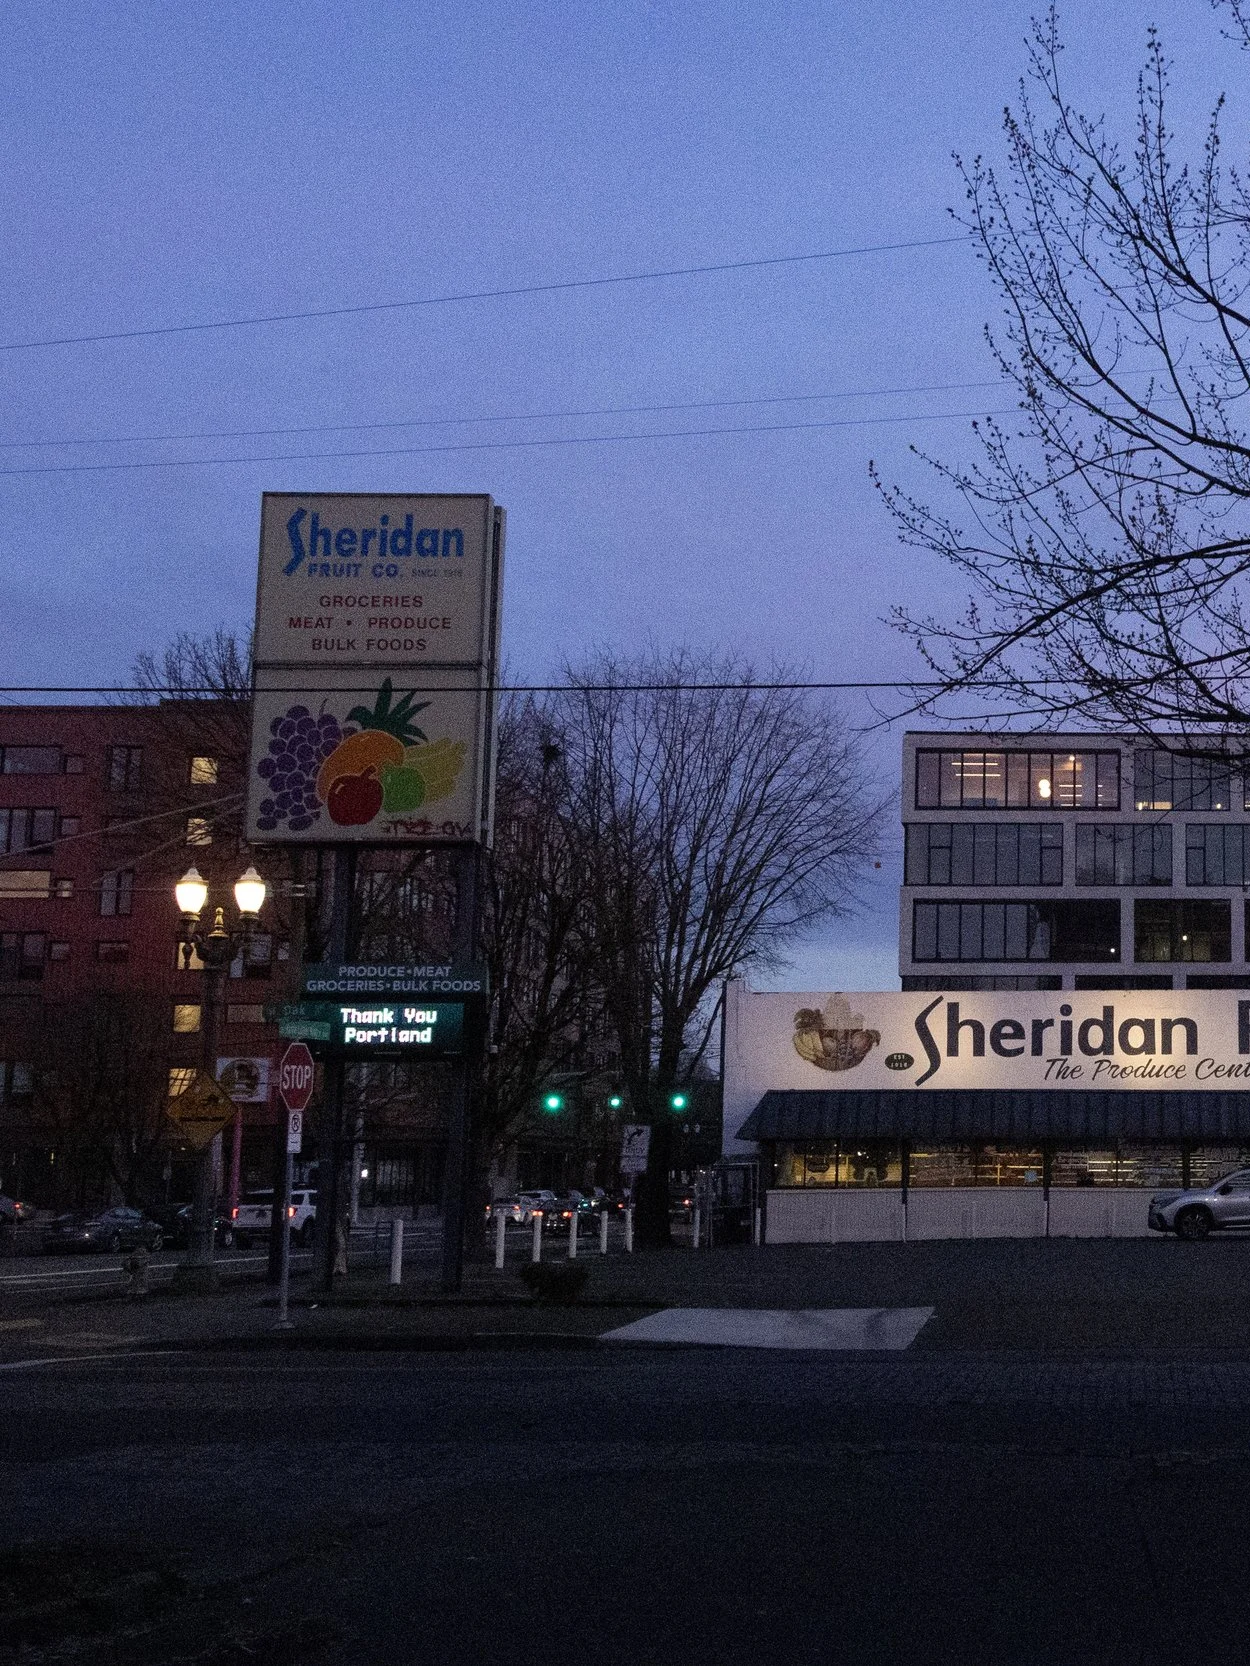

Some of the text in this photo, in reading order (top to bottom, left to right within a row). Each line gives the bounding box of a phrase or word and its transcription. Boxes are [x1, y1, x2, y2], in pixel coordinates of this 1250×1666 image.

[282, 507, 464, 577] Sheridan
[308, 563, 361, 577] FRUIT
[320, 595, 424, 608] GROCERIES
[288, 617, 452, 629] MEAT PRODUCE
[311, 639, 427, 651] BULK FOODS
[339, 966, 452, 977] PRODUCE MEAT
[306, 980, 481, 991] GROCERIES BULK FOODS
[340, 1008, 438, 1023] Thank You
[344, 1027, 433, 1043] Portland
[914, 995, 1198, 1087] Sheridan
[1040, 1058, 1084, 1081] The
[1093, 1057, 1187, 1081] Produce
[282, 1065, 311, 1090] STOP
